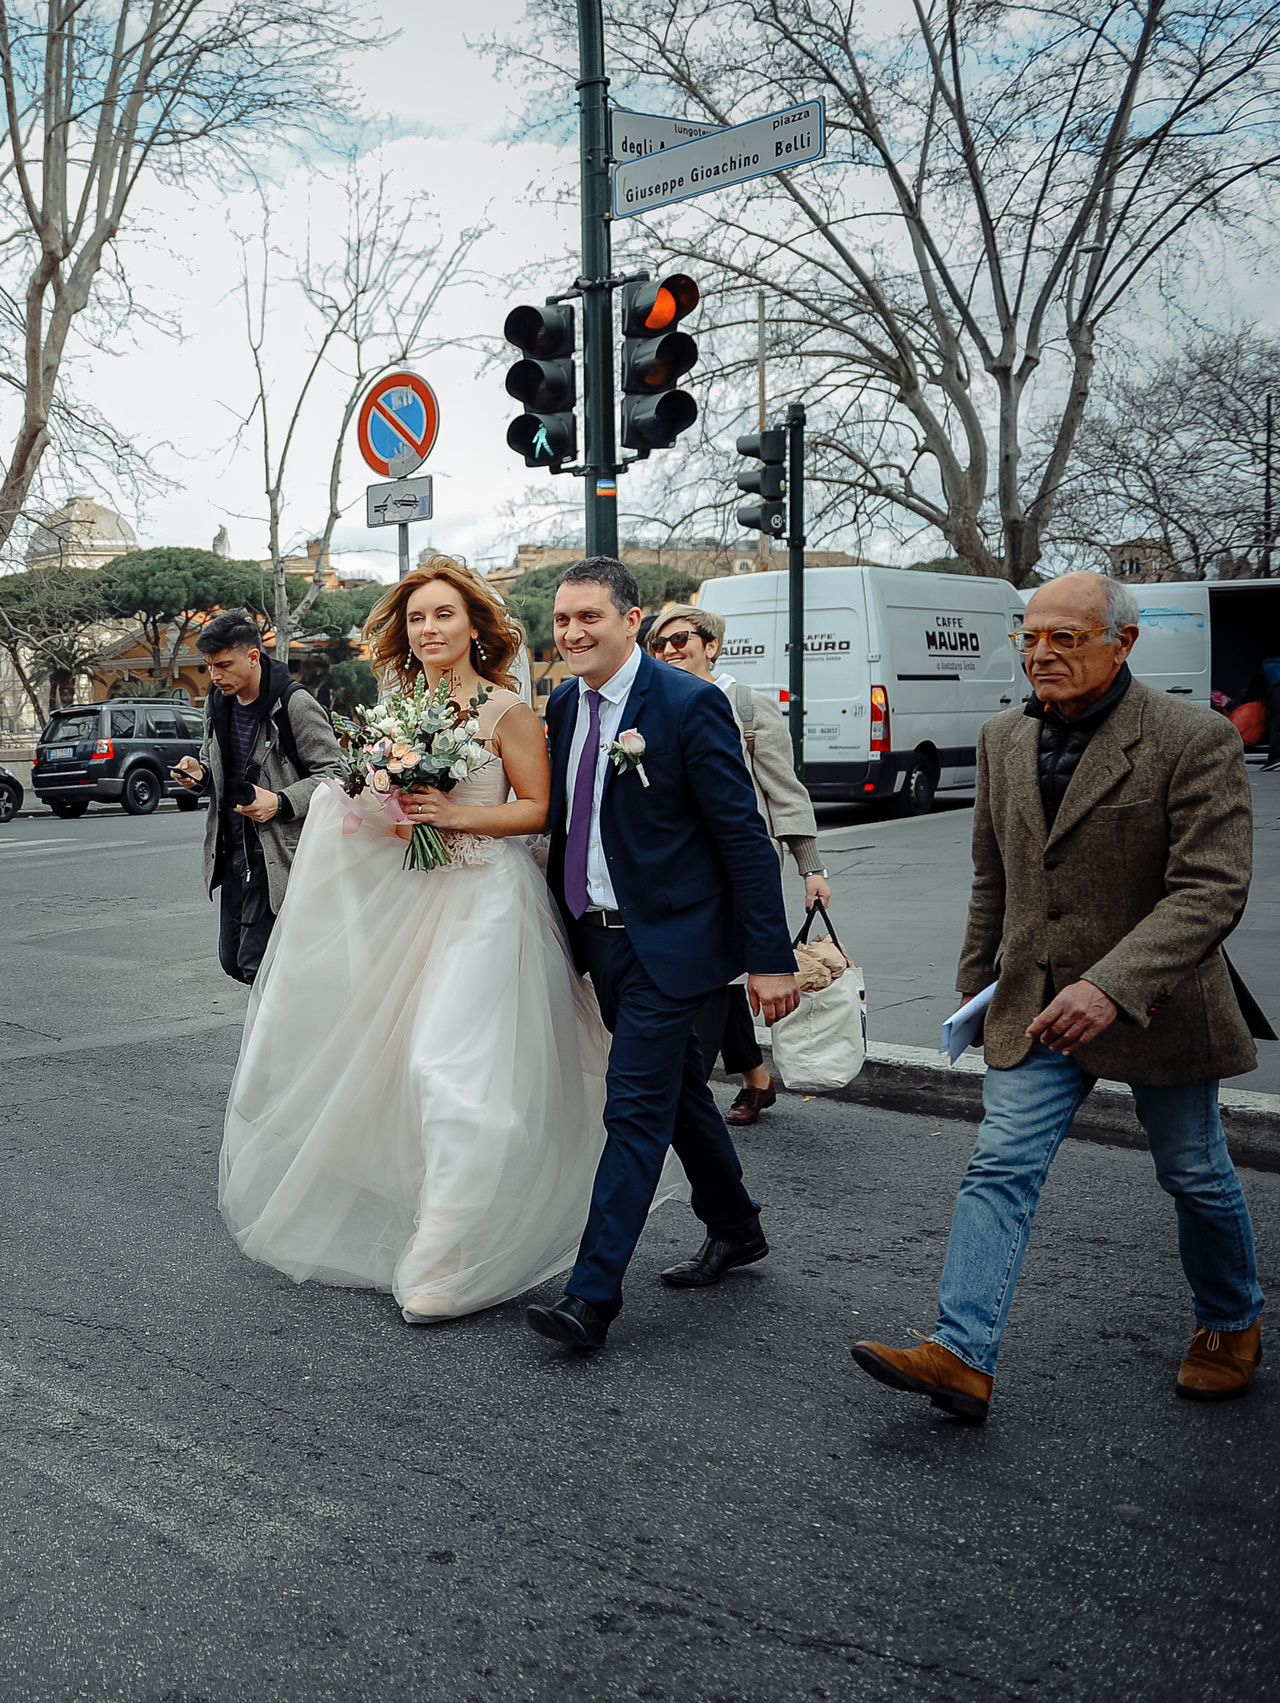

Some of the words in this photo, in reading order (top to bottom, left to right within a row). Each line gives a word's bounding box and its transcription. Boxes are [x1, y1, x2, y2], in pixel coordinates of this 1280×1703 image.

[772, 109, 810, 131] piazza
[621, 135, 653, 158] degli
[625, 175, 685, 203] Giuseppe
[690, 152, 760, 182] Gioachino
[774, 131, 812, 158] Belli
[935, 616, 964, 628] CAFFE'
[720, 645, 765, 656] AURO
[784, 641, 851, 652] AURO
[925, 630, 980, 651] MAURO
